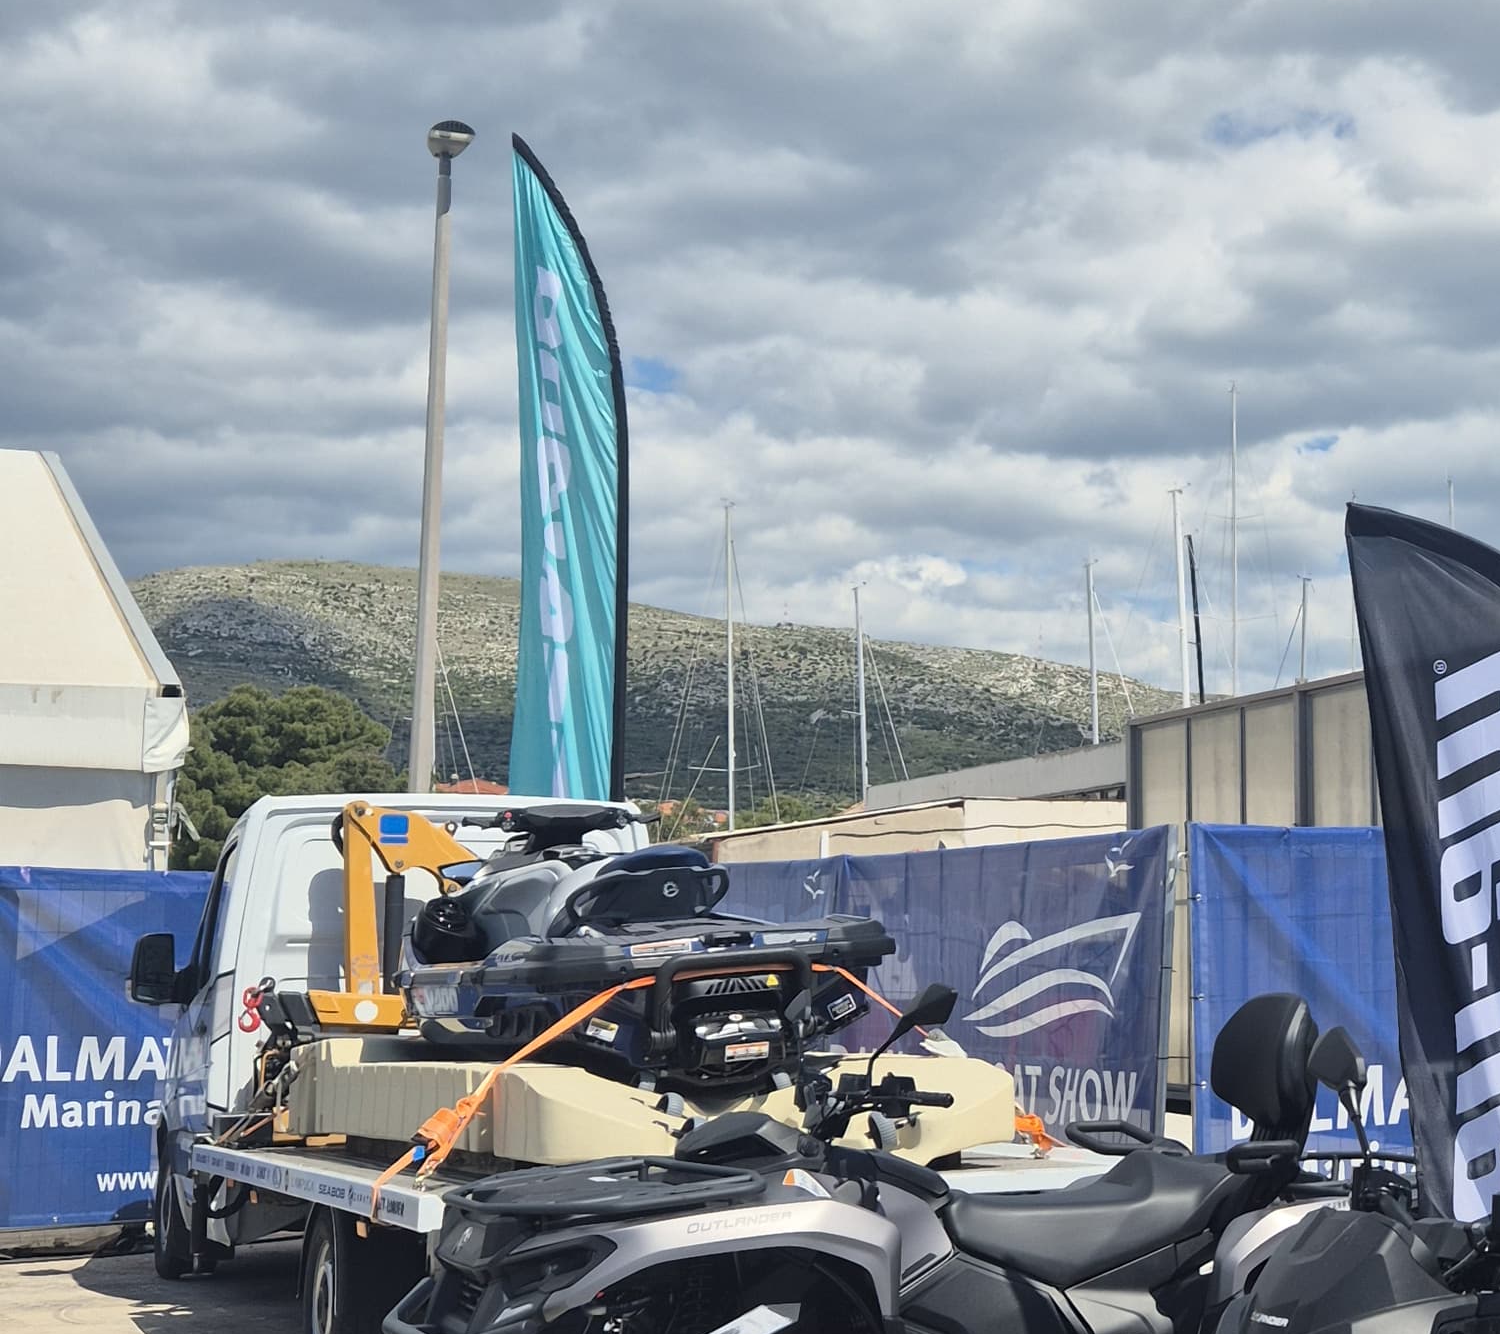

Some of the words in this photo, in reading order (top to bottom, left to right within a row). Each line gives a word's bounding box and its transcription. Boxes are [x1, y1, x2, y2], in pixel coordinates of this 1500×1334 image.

[0, 1035, 172, 1083] ALMA
[20, 1090, 162, 1129] Marina
[1046, 1065, 1138, 1126] SHOW
[687, 1211, 792, 1235] OUTLANDER
